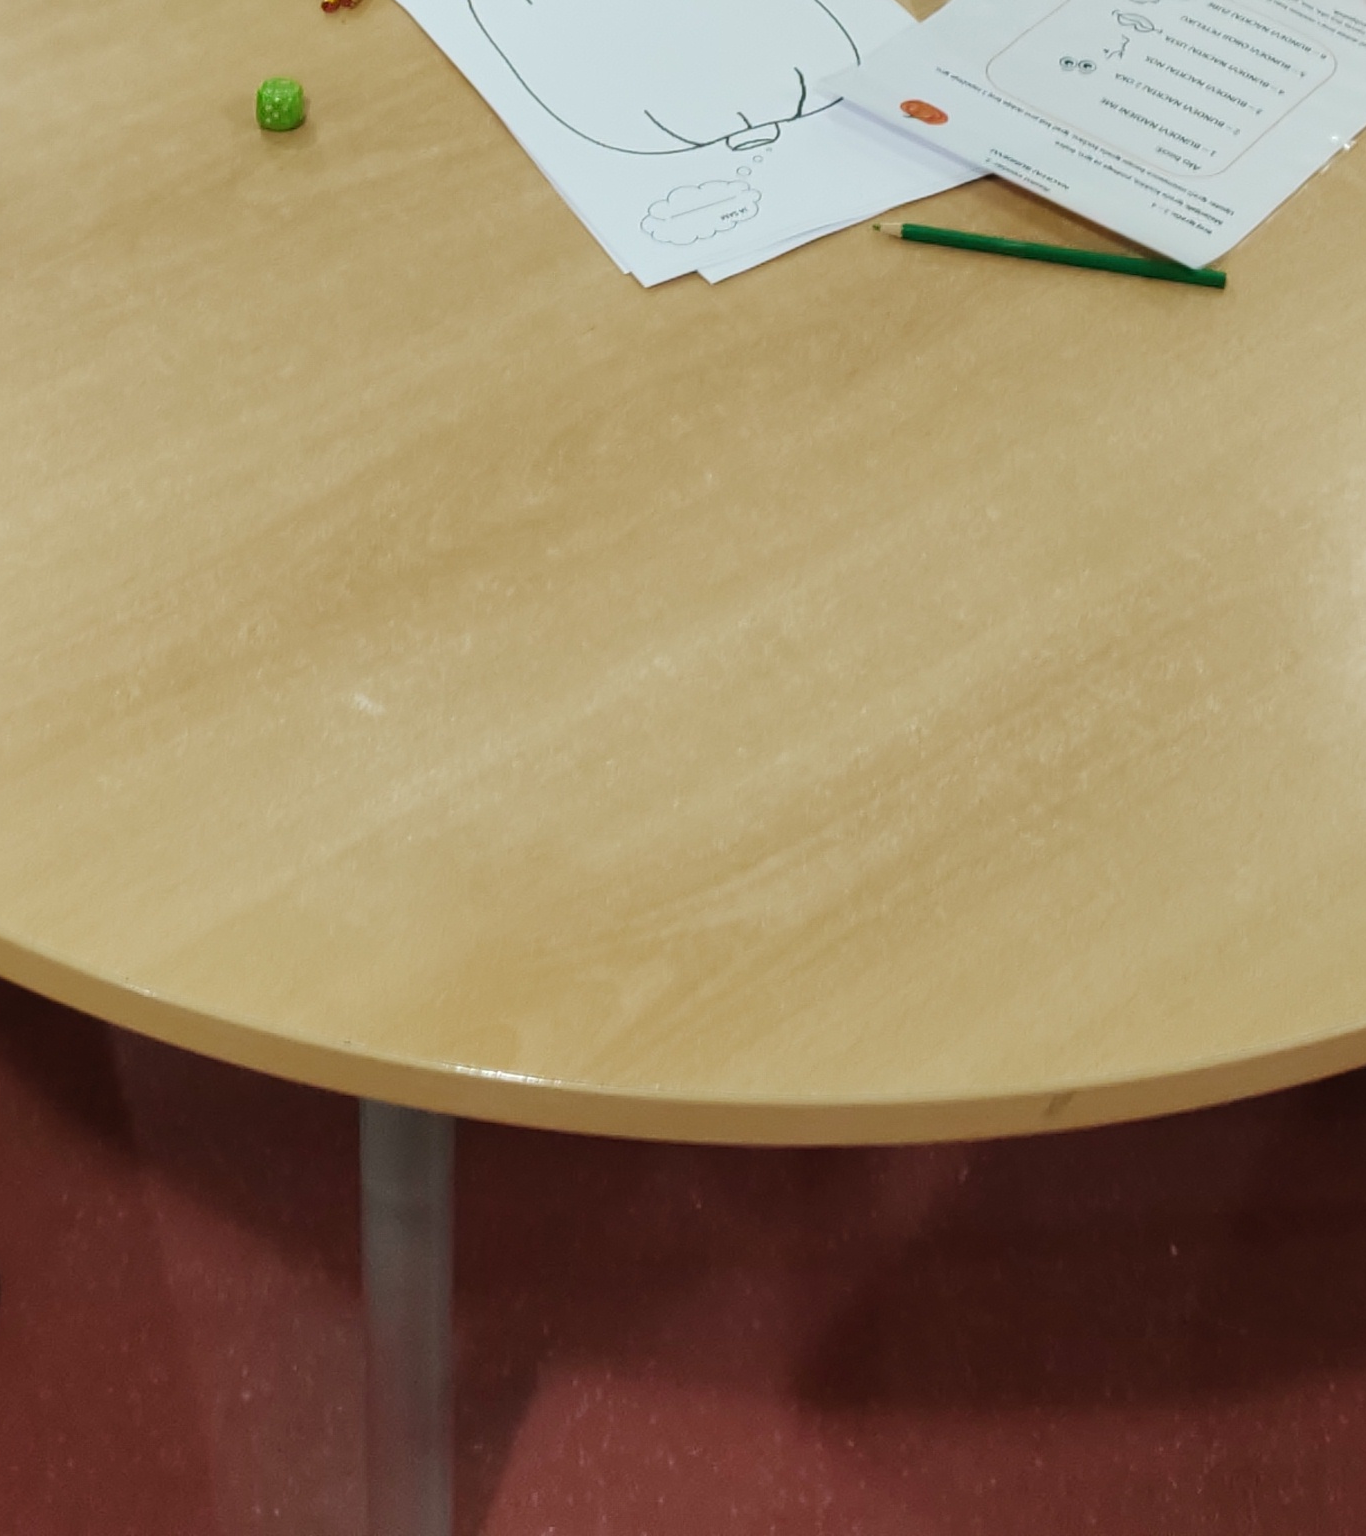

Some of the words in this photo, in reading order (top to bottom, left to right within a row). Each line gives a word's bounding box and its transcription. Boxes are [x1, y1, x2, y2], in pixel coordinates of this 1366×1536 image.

[1202, 83, 1250, 108] BUNDEVI
[1179, 103, 1227, 127] BUNDEVI
[1155, 125, 1203, 149] BUNDEVI
